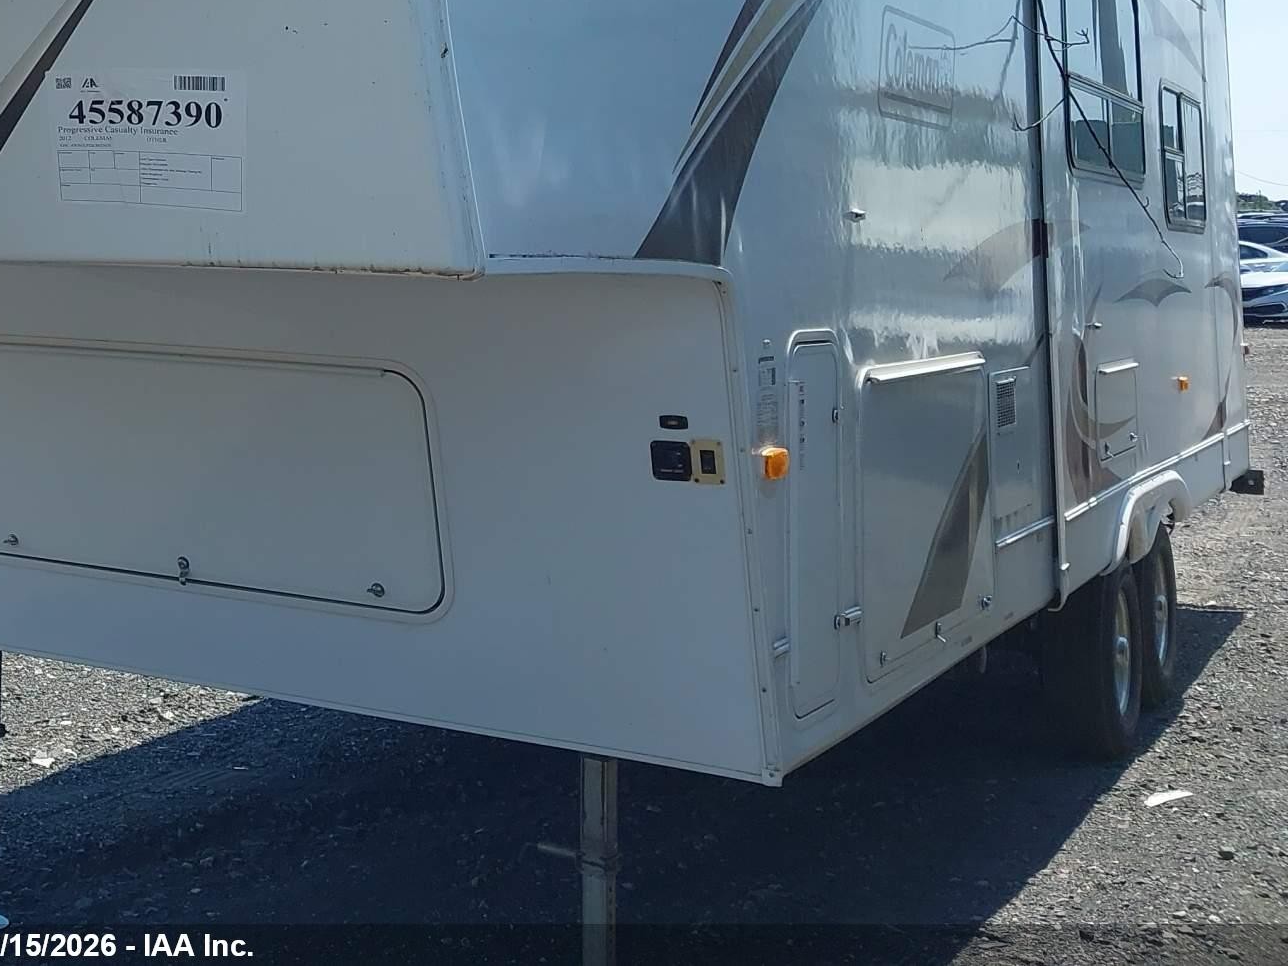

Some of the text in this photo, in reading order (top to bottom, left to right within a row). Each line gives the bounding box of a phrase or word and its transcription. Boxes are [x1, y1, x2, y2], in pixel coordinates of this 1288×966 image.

[69, 99, 223, 129] 45587390
[58, 126, 179, 136] Progressive Casualty Insurance
